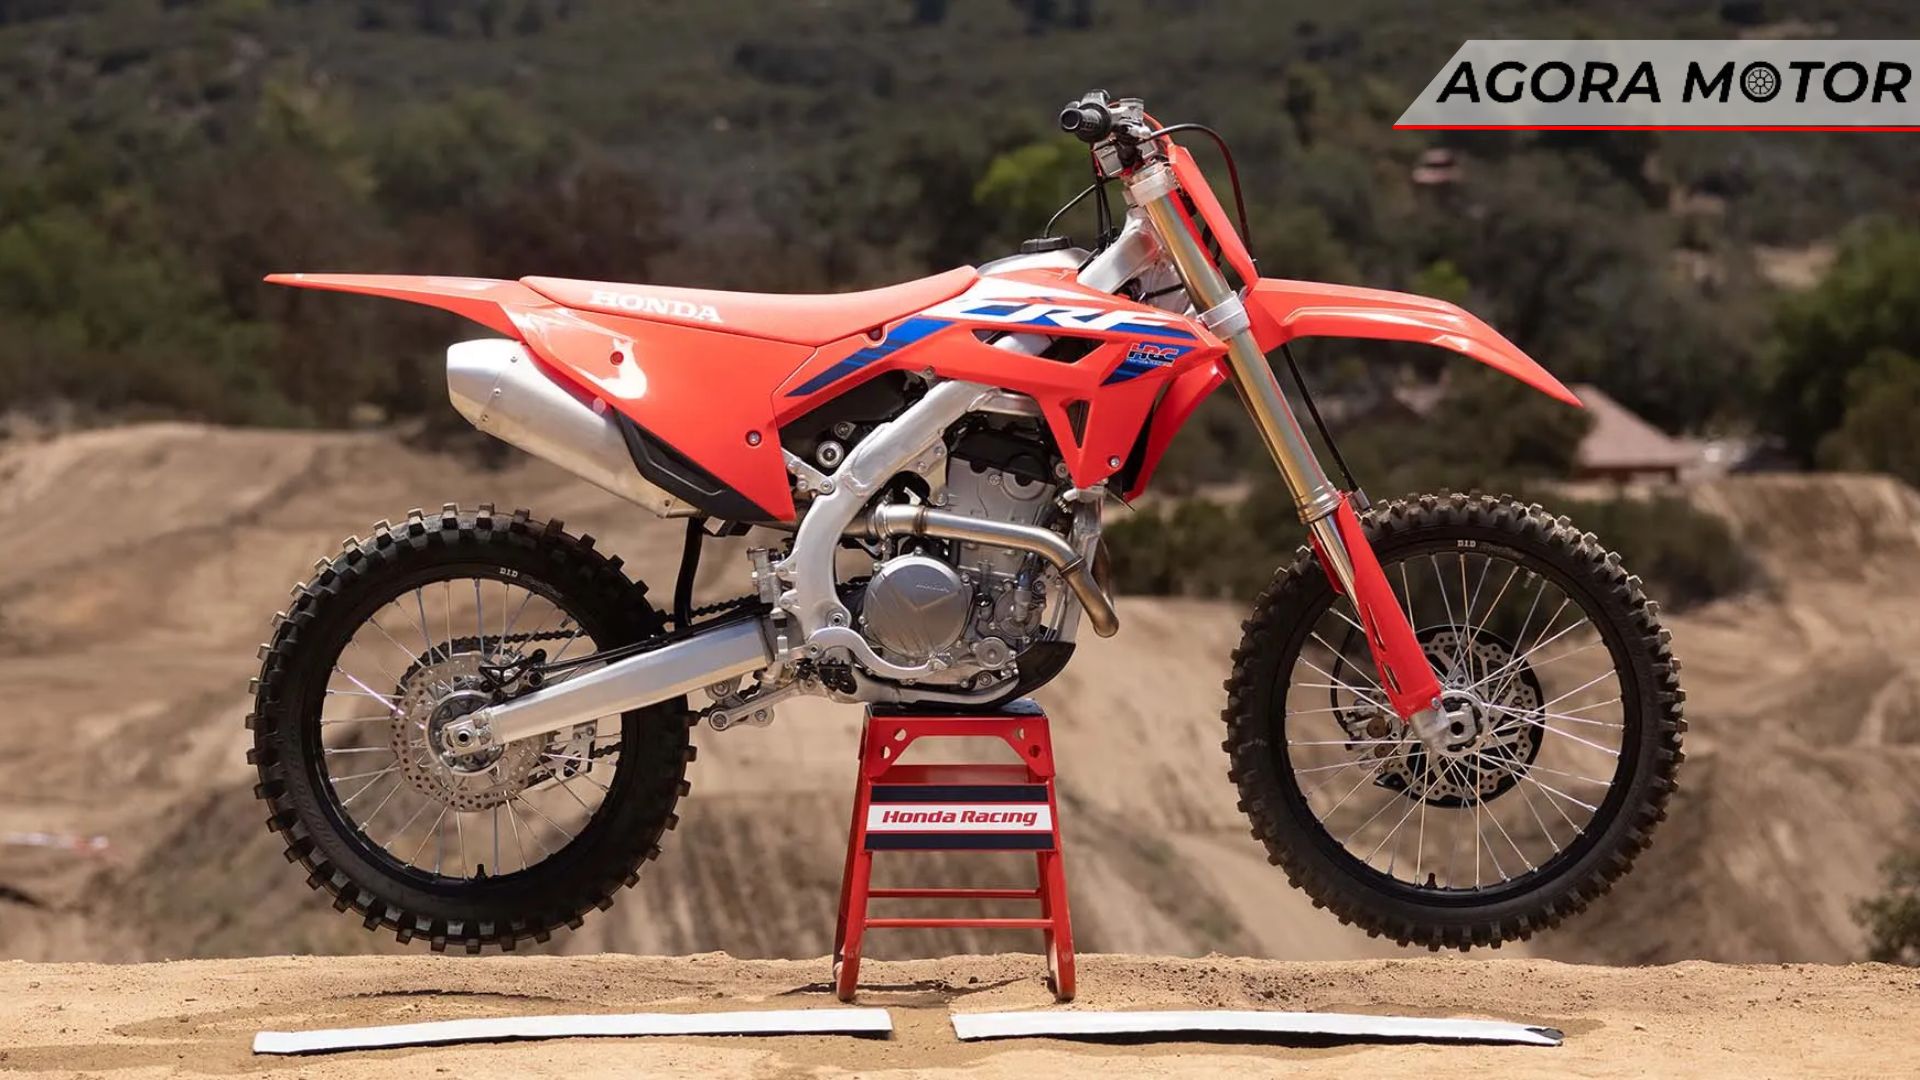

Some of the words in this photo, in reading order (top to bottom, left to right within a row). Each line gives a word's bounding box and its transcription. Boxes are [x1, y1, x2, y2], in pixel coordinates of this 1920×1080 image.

[588, 290, 723, 324] HONDA
[945, 297, 1183, 331] CRF
[1127, 343, 1179, 365] HRC
[882, 810, 956, 824] Honda
[960, 810, 1038, 826] Racing
